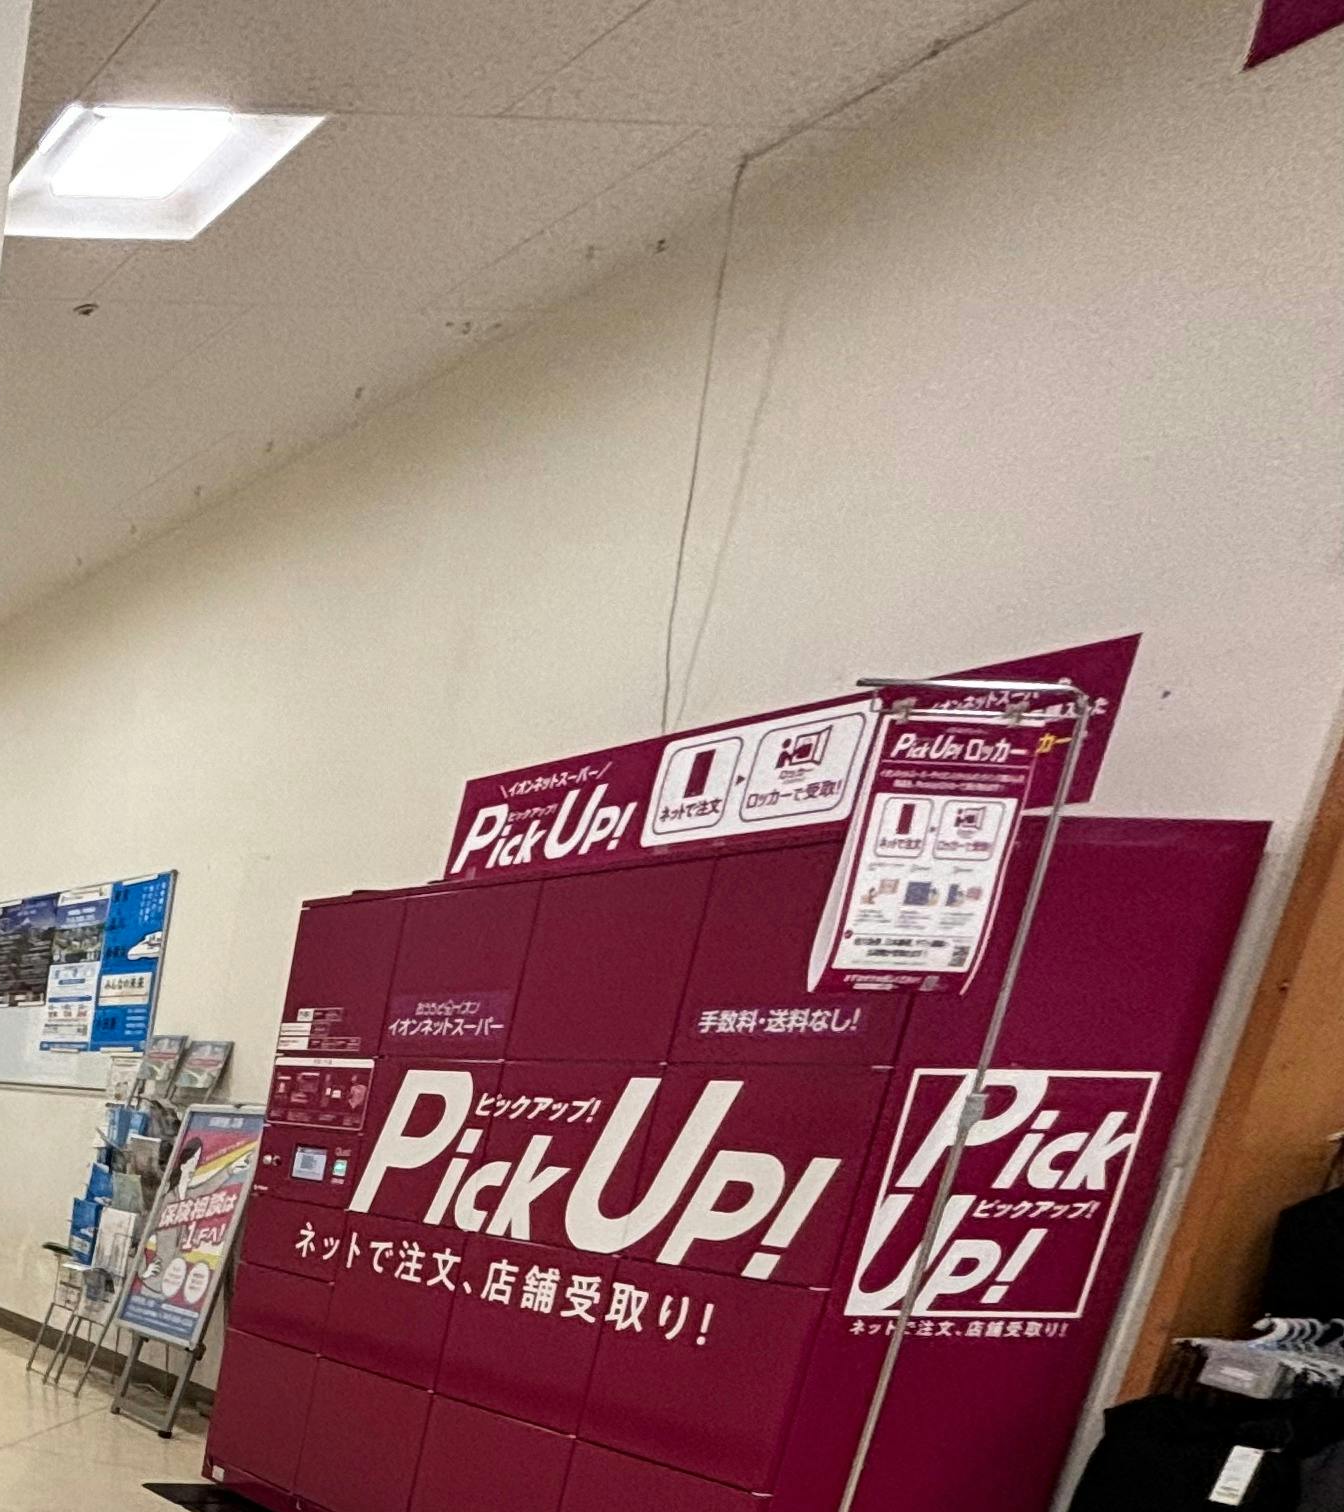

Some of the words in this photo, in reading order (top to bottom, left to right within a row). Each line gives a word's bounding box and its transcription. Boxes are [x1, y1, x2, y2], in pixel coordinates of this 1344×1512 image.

[964, 737, 1029, 763] ロッカー
[388, 1016, 505, 1037] イオンネットスーパー
[698, 1008, 862, 1033] 手数料・送料なし!
[474, 1092, 602, 1123] ピックアップ!
[894, 1071, 1137, 1190] Pick
[972, 1200, 1101, 1219] ピックアップ!
[294, 1221, 715, 1346] ネットで注文、店舗受取り!
